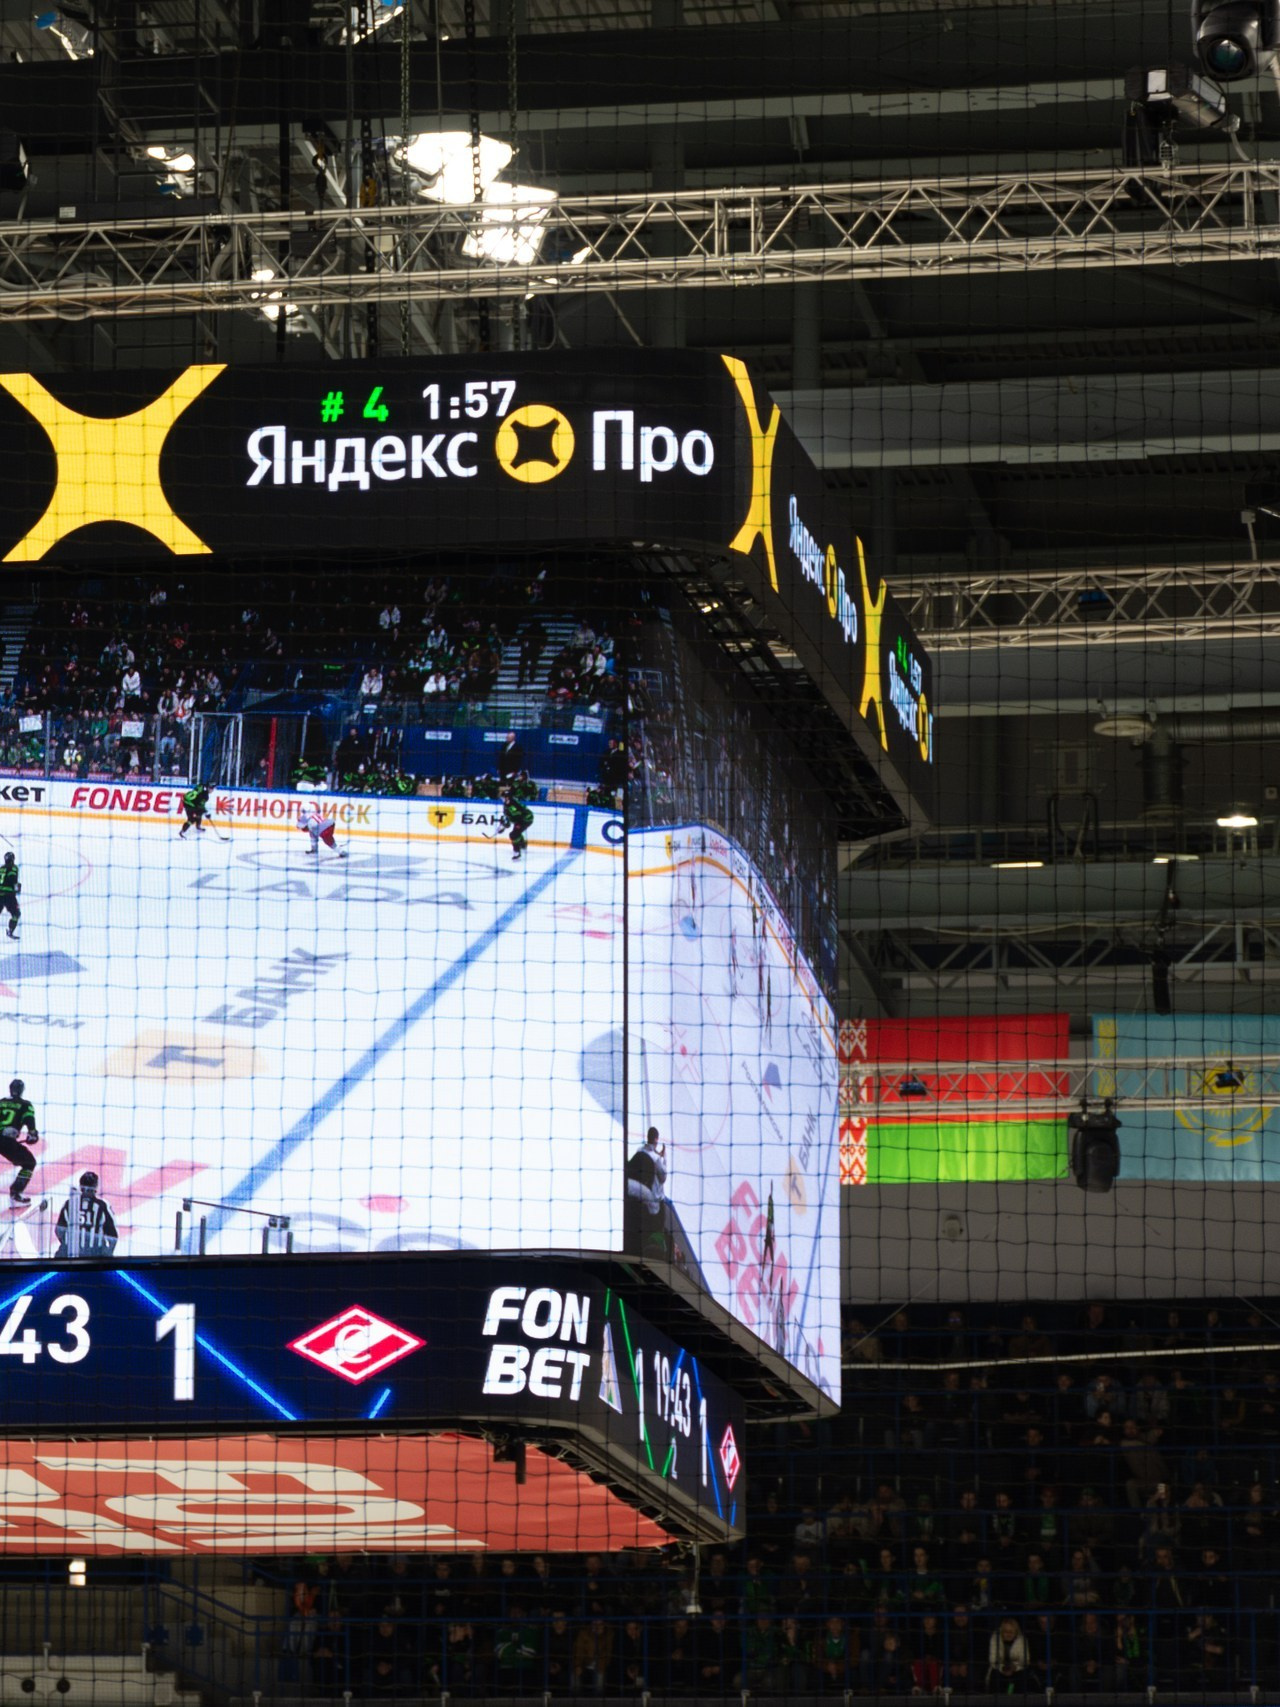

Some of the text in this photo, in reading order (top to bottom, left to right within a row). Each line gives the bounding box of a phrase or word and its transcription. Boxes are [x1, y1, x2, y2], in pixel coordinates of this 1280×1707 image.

[363, 386, 389, 422] 4
[422, 380, 517, 420] 1:57
[246, 410, 715, 492] Яндекс Про
[461, 813, 506, 826] БАН
[201, 947, 352, 1029] БАНК
[482, 1286, 590, 1344] FON
[155, 1303, 196, 1400] 1
[482, 1344, 590, 1401] BET
[654, 1350, 691, 1438] 19:43
